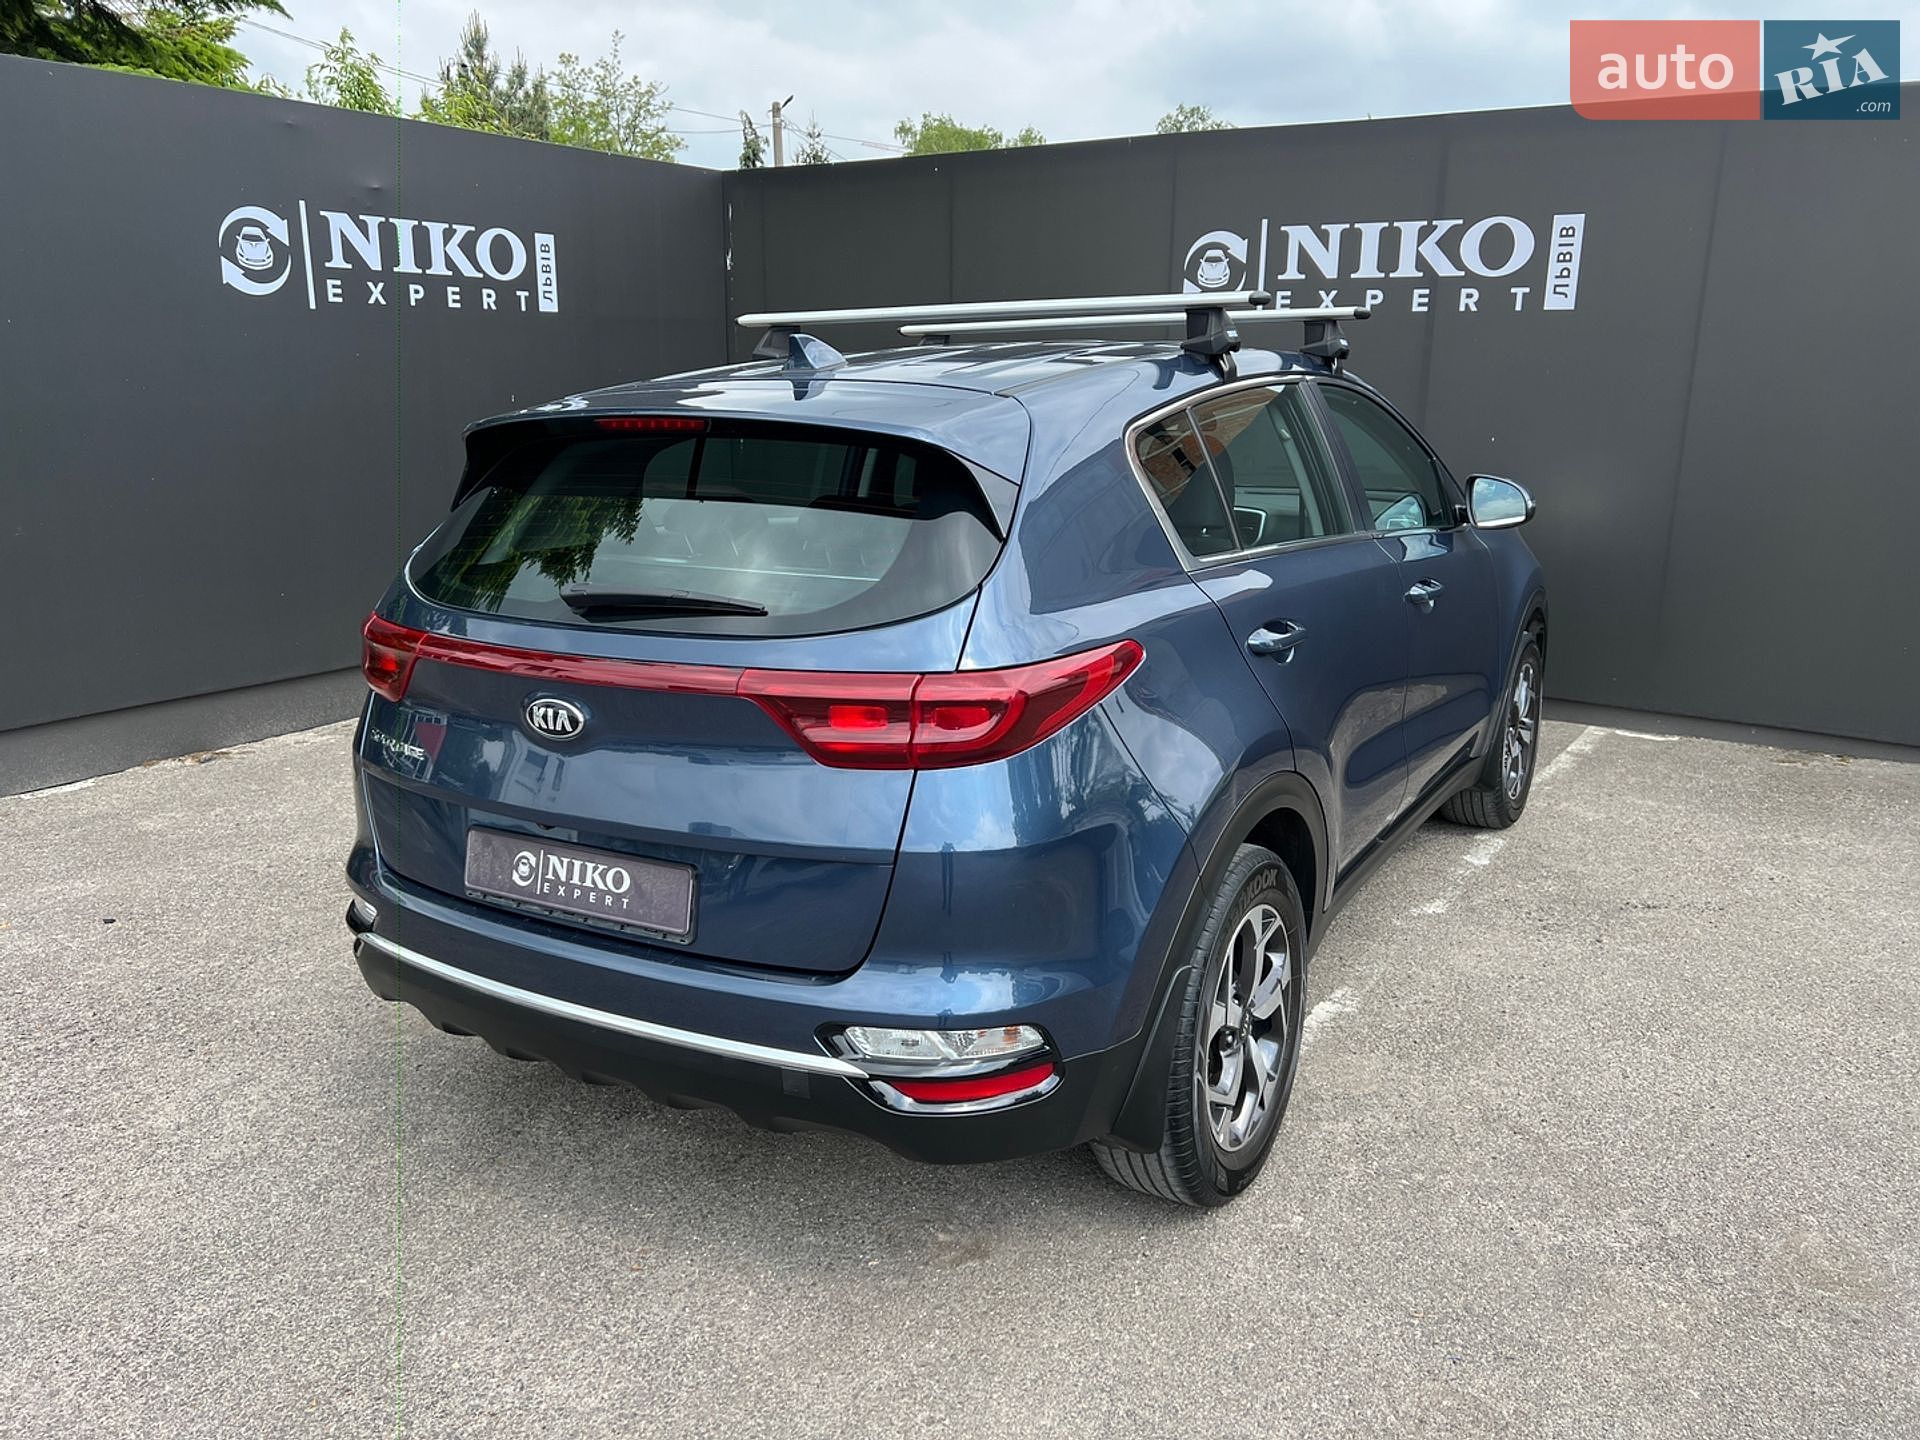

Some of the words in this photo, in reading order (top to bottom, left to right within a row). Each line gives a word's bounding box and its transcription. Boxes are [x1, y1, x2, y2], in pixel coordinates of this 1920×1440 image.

[319, 210, 527, 282] NIKO
[1277, 216, 1535, 280] NIKO
[326, 279, 530, 312] EXPERT
[1275, 287, 1531, 312] EXPERT
[532, 705, 573, 733] KIA
[545, 854, 631, 894] NIKO
[543, 884, 630, 910] EXPERT
